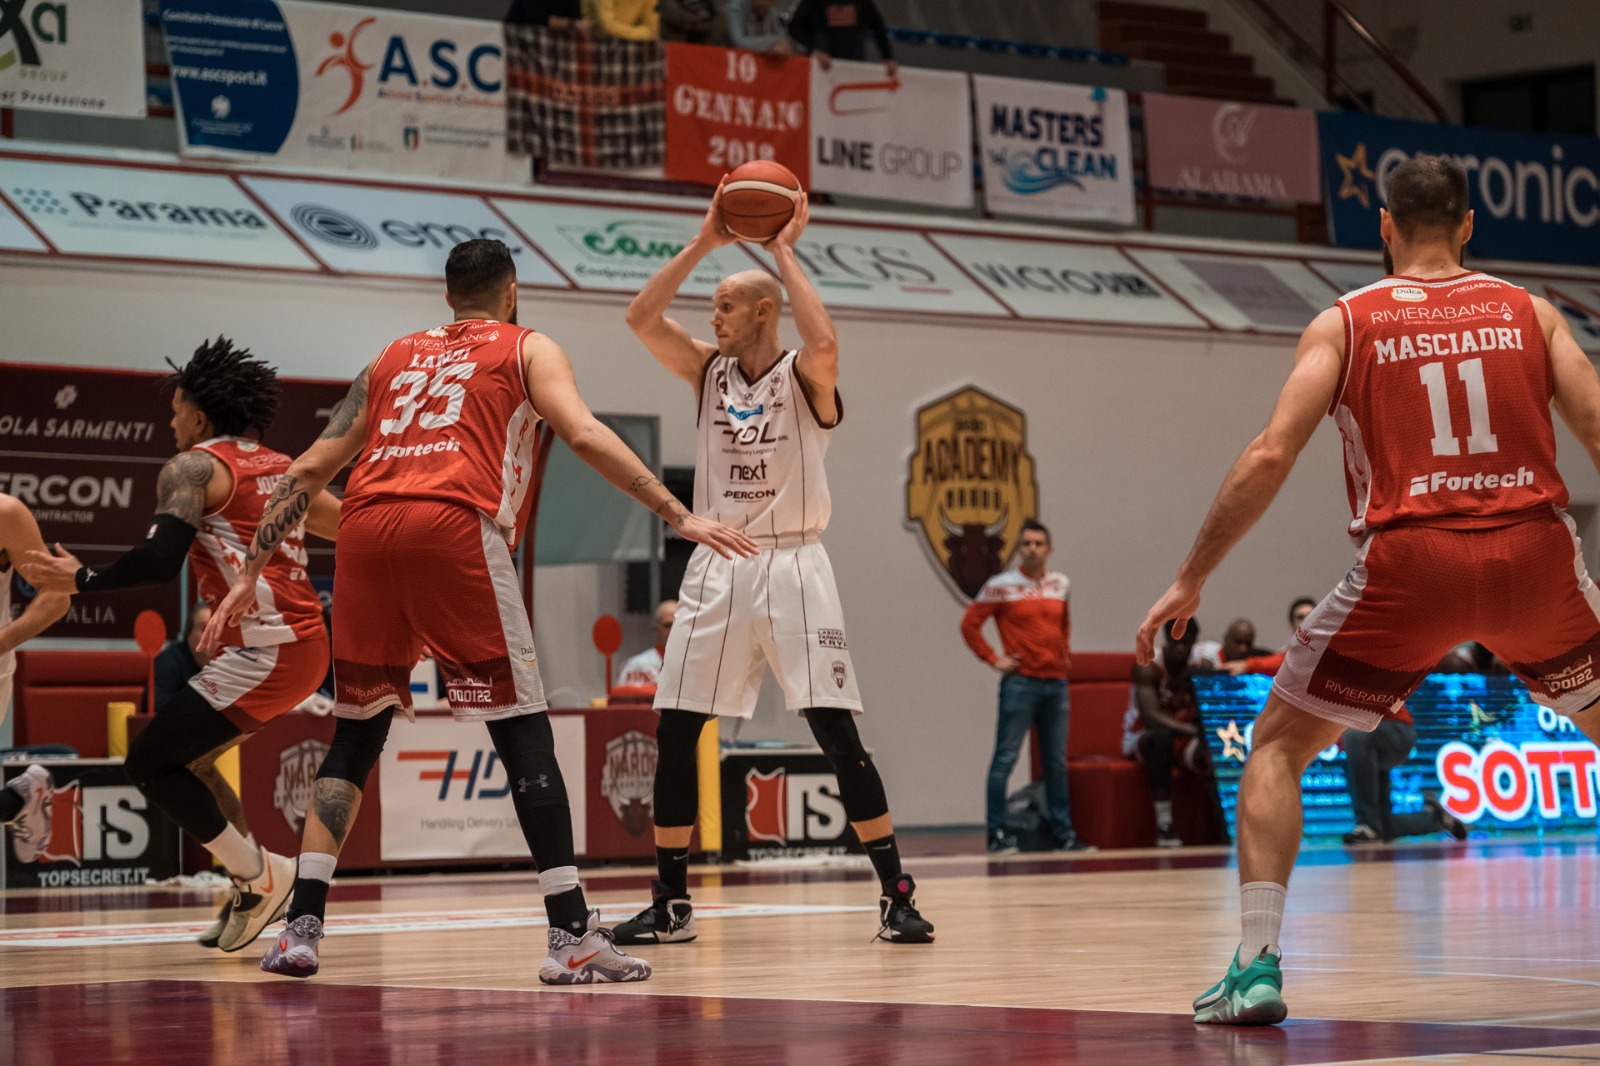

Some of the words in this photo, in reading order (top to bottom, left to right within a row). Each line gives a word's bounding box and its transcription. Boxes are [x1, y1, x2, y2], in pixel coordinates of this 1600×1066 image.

[725, 51, 758, 82] 10
[990, 103, 1104, 148] MASTERS
[817, 137, 875, 171] LINE
[878, 142, 964, 181] GROUP
[1033, 147, 1118, 181] CLEAN
[1176, 166, 1288, 199] ALABAMA
[69, 191, 268, 230] Parama
[1456, 282, 1502, 293] DELLAROSA
[1371, 302, 1514, 325] RIVIERABANCA
[1374, 327, 1524, 365] MASCIADRI
[379, 361, 478, 437] 35
[1418, 357, 1498, 456] 11
[43, 417, 155, 443] SARMENTI
[383, 436, 461, 461] Fortech
[730, 458, 767, 480] next
[1431, 466, 1534, 493] Fortech
[723, 488, 776, 500] PERCON
[421, 817, 465, 831] Handling
[467, 815, 503, 830] Delivery
[38, 867, 150, 888] TOPSECRET.IT
